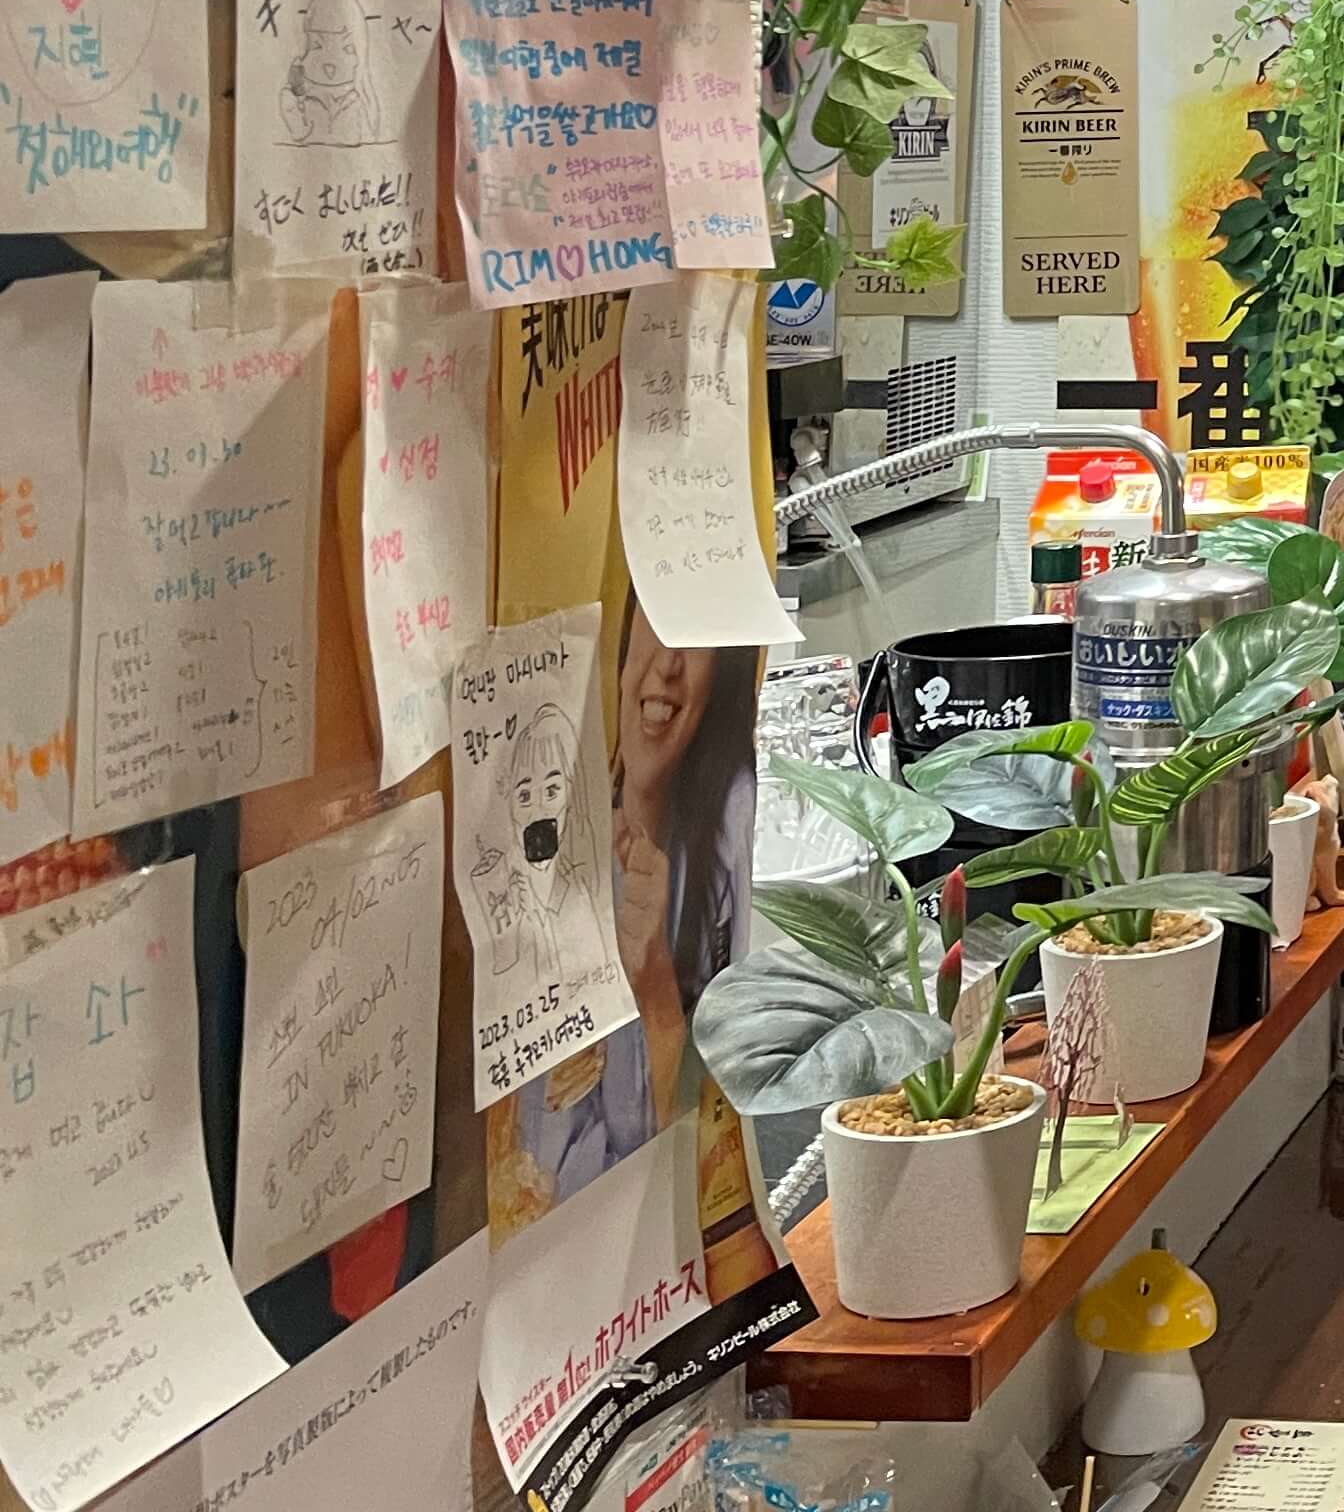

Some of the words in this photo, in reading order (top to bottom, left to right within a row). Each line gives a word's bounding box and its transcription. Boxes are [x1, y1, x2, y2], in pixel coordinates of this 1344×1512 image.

[1015, 62, 1052, 95] KIRIN'S
[1054, 58, 1091, 73] PRIME
[1092, 65, 1121, 95] BREW
[1021, 119, 1071, 134] KIRIN
[1075, 118, 1118, 132] BEER
[898, 130, 936, 157] KIRIN
[480, 248, 556, 294] RIM
[588, 232, 674, 274] HONG
[1021, 251, 1121, 272] SERVED
[1036, 275, 1107, 295] HERE
[1103, 622, 1153, 636] DUSKIN
[506, 641, 570, 684] 마시니까
[479, 984, 560, 1050] 2023.03.25
[594, 1258, 704, 1374] ホワイトホース
